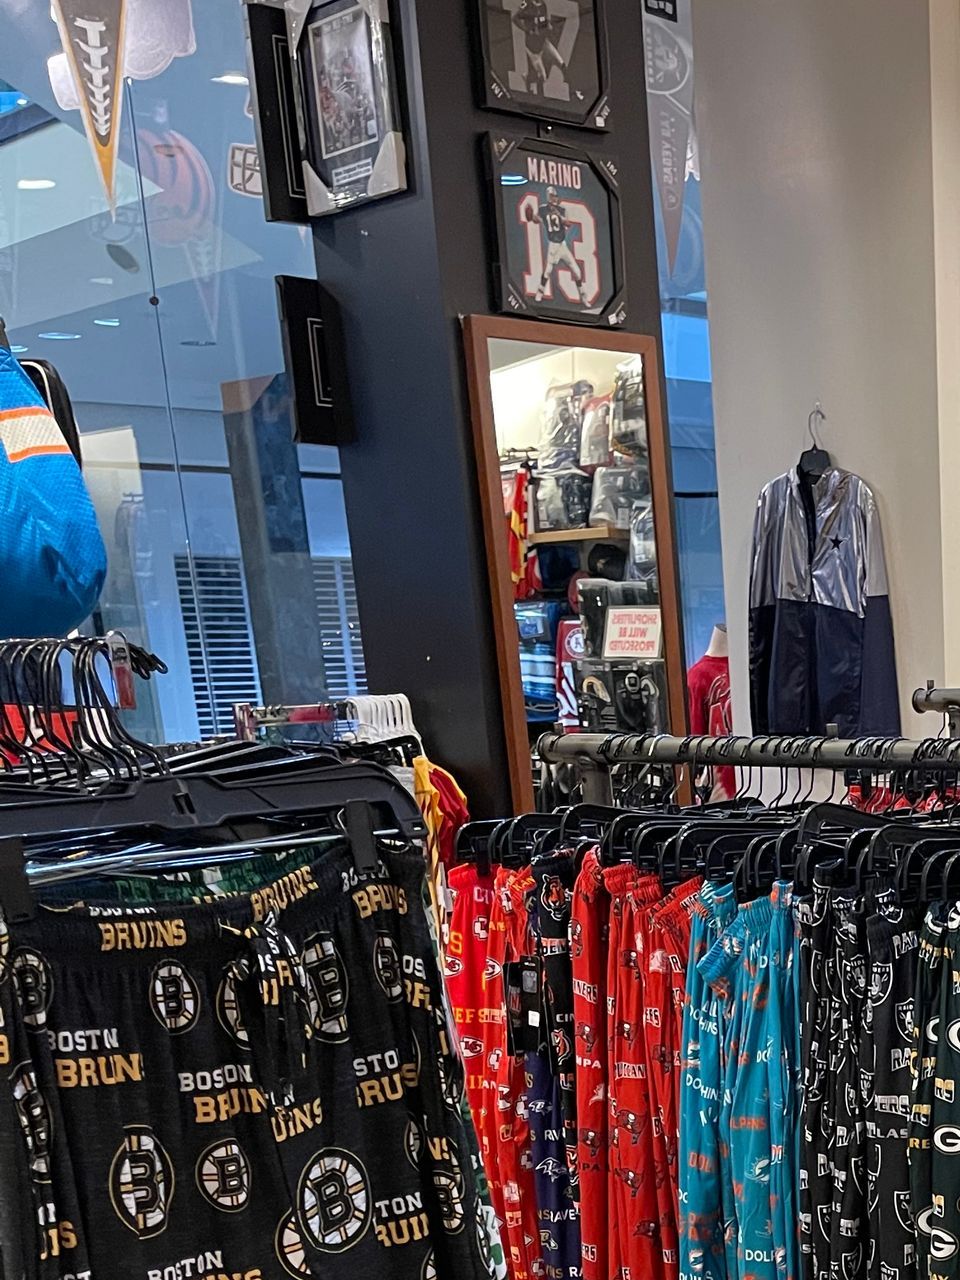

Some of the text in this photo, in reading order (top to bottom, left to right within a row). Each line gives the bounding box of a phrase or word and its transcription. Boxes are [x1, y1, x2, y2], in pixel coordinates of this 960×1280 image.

[527, 157, 581, 189] MARINO
[546, 214, 560, 232] 13
[518, 192, 600, 305] 13
[100, 919, 187, 951] BRUINS
[194, 1086, 268, 1123] BRUIN
